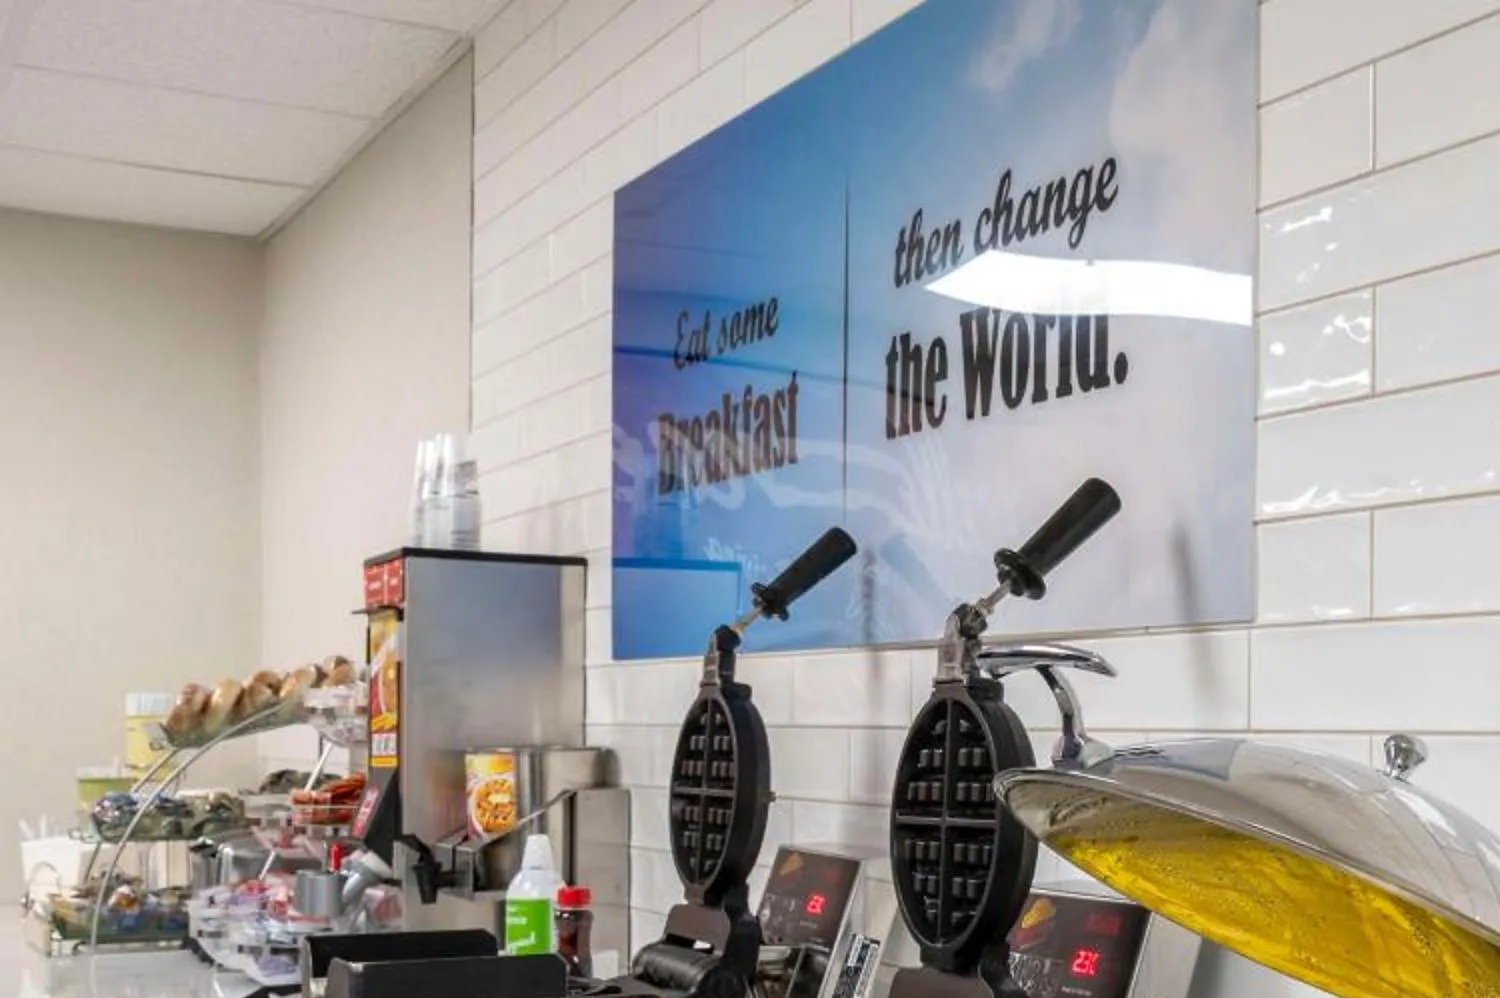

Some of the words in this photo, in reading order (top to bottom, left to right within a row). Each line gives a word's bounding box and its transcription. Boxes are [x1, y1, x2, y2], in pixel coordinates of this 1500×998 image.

[895, 208, 964, 288] then
[974, 157, 1119, 255] change
[673, 309, 711, 370] Eat
[717, 297, 779, 354] some
[885, 332, 948, 440] the
[960, 304, 1129, 420] World.
[657, 369, 799, 495] Breakfast
